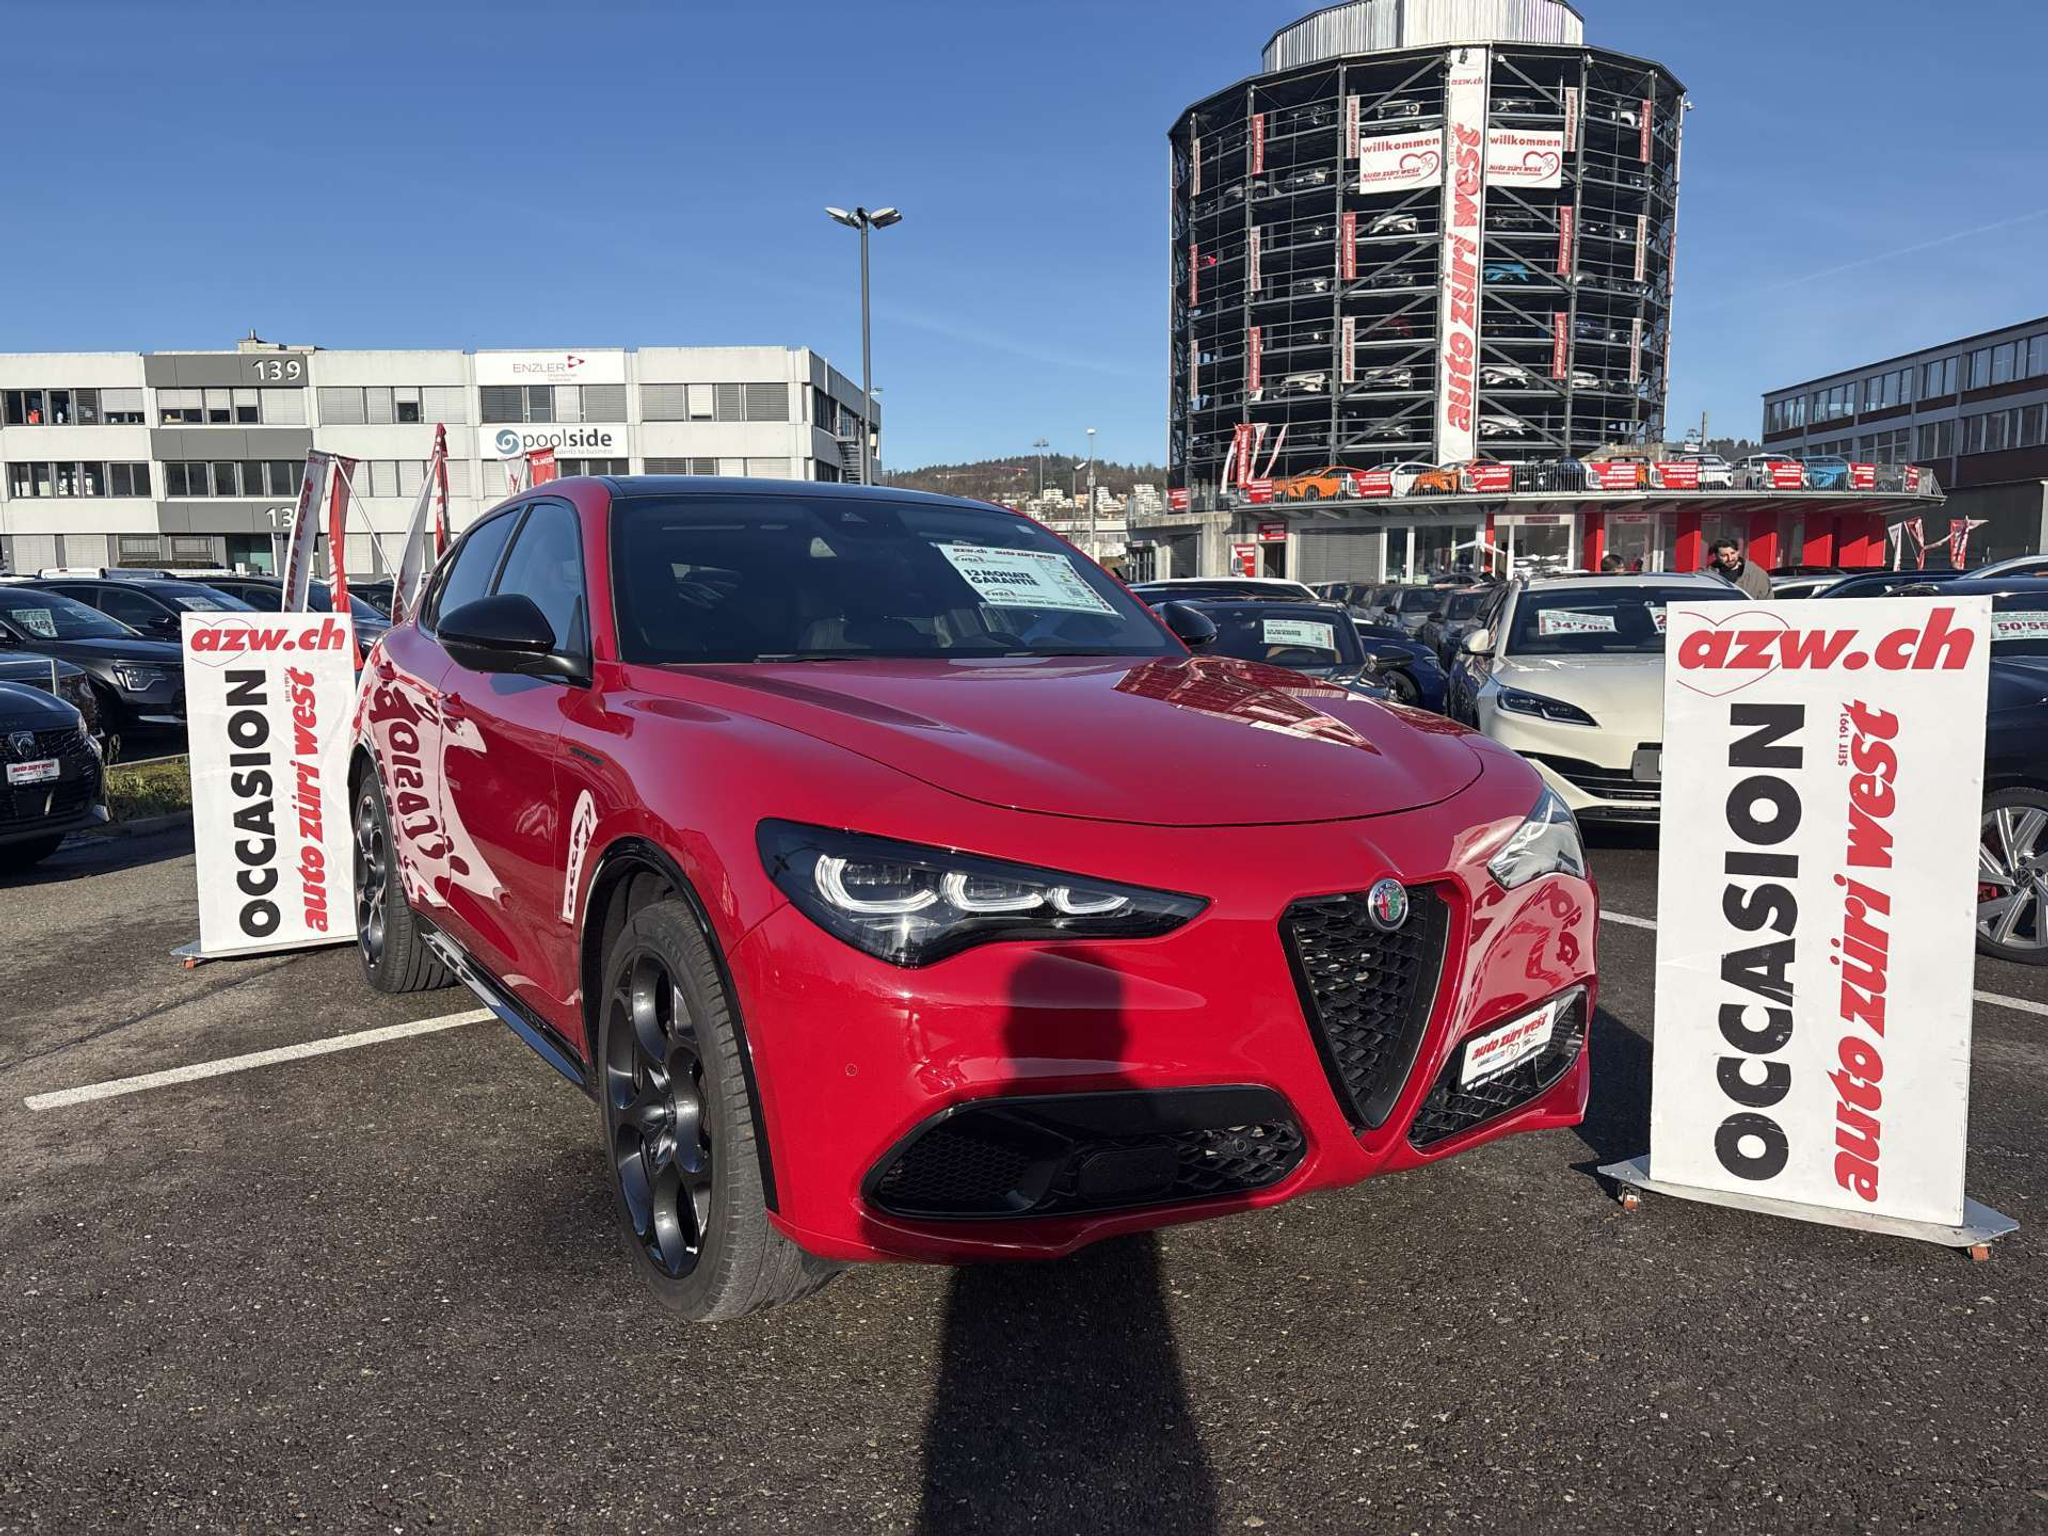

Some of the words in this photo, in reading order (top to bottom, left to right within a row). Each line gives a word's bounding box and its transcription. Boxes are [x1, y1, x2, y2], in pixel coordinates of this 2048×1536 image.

[1362, 137, 1440, 153] willkommen
[1490, 134, 1561, 147] willkommen
[1451, 122, 1481, 227] west
[1446, 232, 1477, 330] züri
[253, 360, 301, 380] 139
[512, 362, 566, 373] ENZLER
[1445, 332, 1474, 433] auto
[523, 428, 612, 448] poolside
[265, 507, 293, 527] 13
[970, 576, 1041, 587] GARANTIE
[982, 570, 1034, 580] MONATE
[191, 618, 345, 651] azw.ch
[1679, 607, 1974, 670] azw.ch
[1997, 622, 2048, 631] 50'55
[284, 666, 319, 756] west
[1839, 713, 1849, 739] 1991
[1837, 743, 1848, 767] SEIT
[224, 669, 281, 938] OCCASION
[290, 759, 323, 844] züri
[1842, 699, 1899, 868] west
[295, 845, 329, 932] auto
[1714, 703, 1805, 1181] OCCASION
[1830, 873, 1891, 1039] züri
[1472, 1039, 1500, 1061] auto
[1499, 1024, 1524, 1049] züri
[1524, 1012, 1548, 1035] west
[1827, 1036, 1885, 1202] auto
